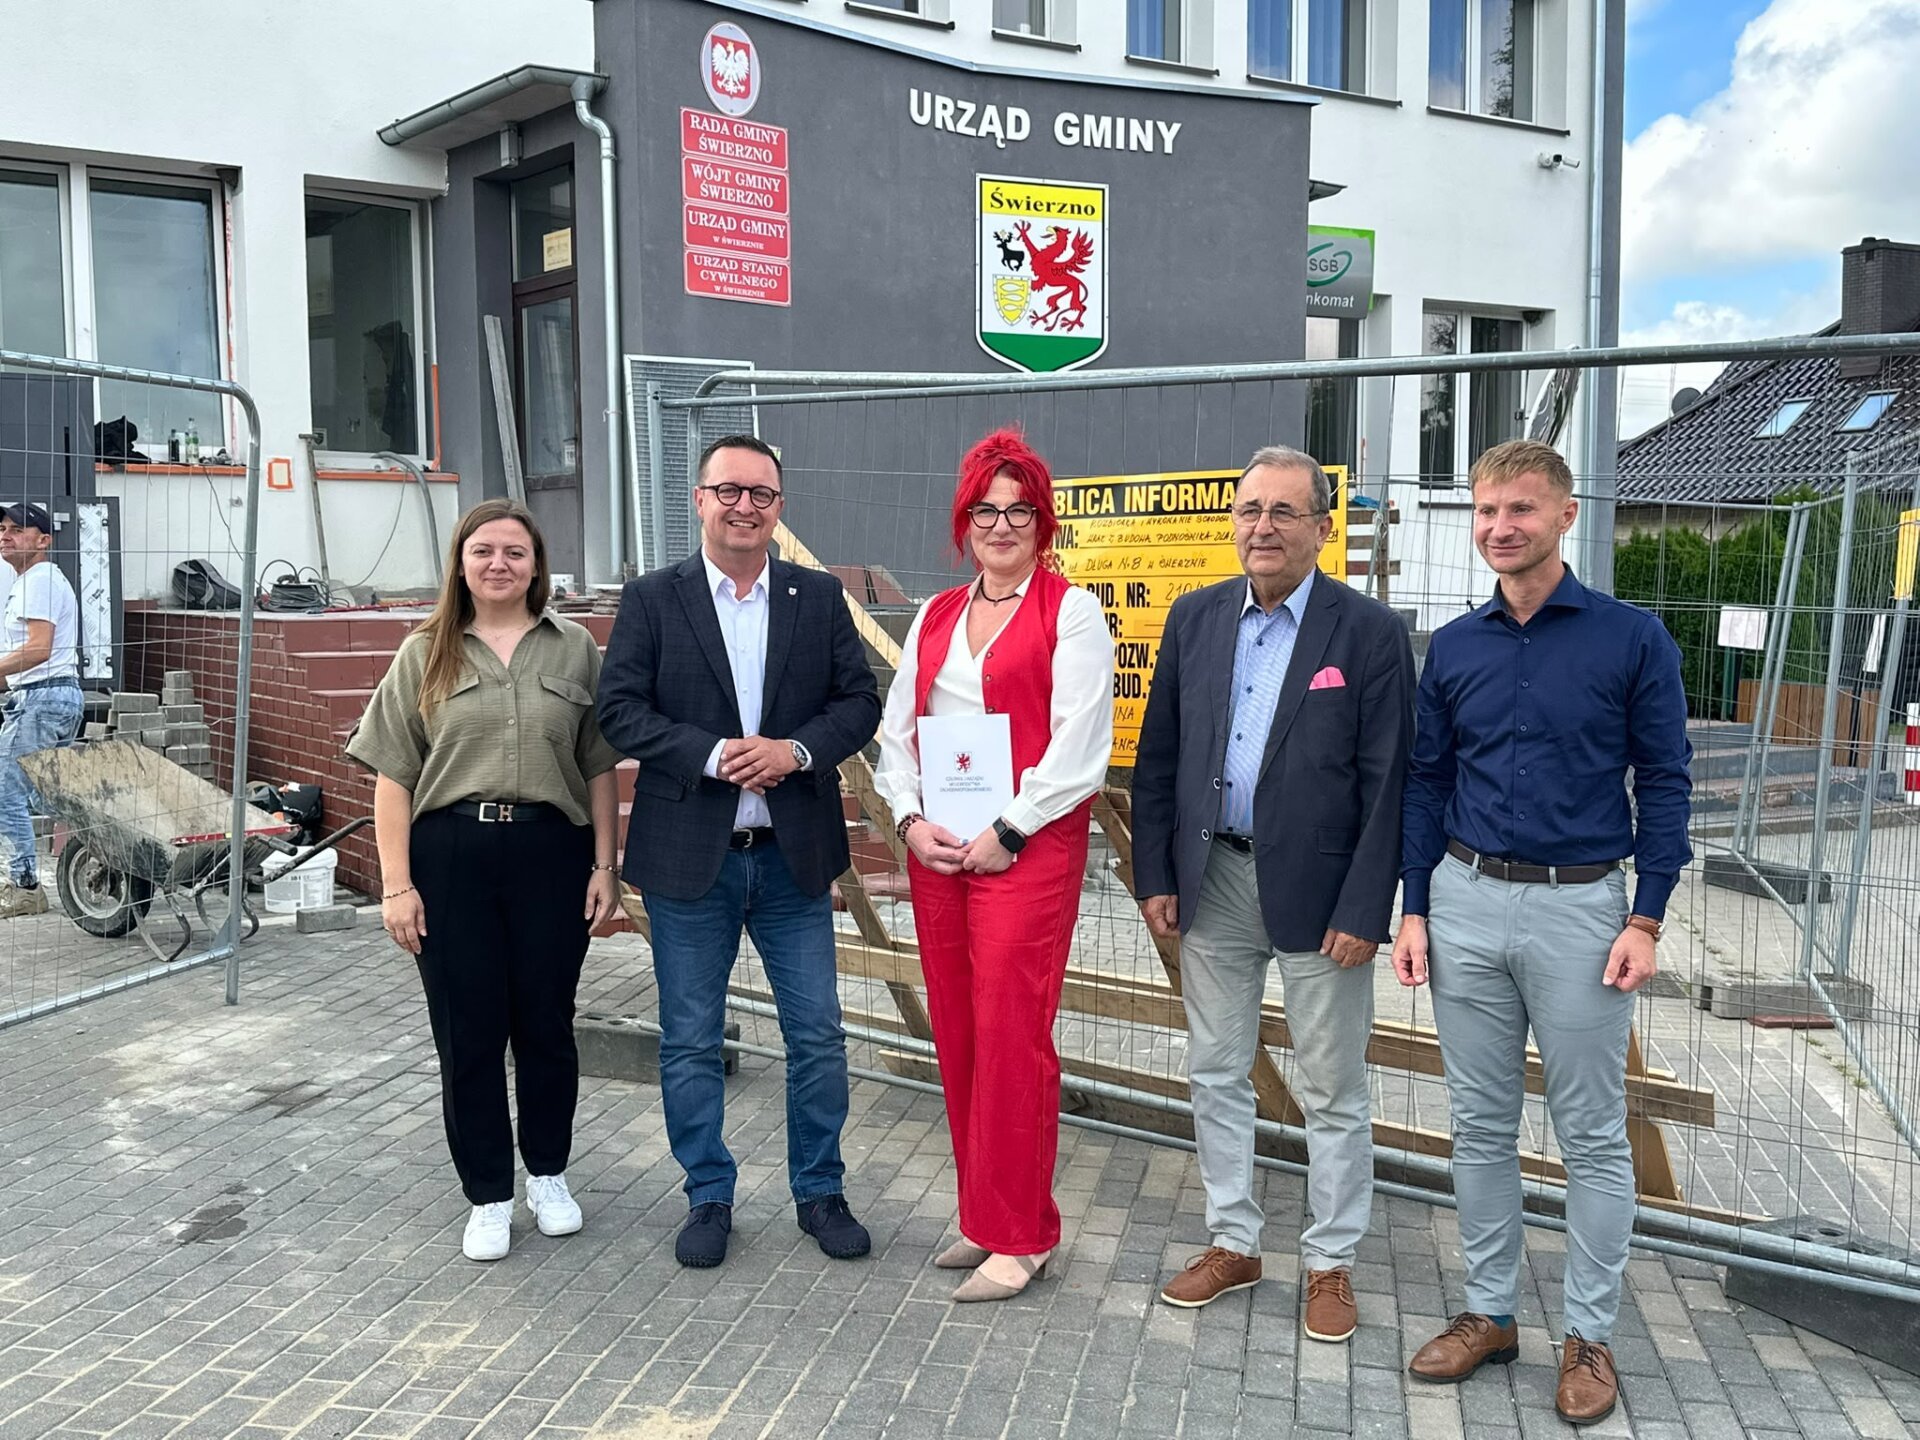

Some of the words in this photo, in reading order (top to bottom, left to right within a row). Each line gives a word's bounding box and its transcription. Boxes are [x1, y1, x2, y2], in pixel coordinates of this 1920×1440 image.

[690, 114, 731, 136] RADA
[733, 123, 780, 145] GMINY
[909, 88, 1031, 148] URZĄD
[1053, 111, 1182, 154] GMINY
[698, 133, 773, 163] ŚWIERZNO
[691, 163, 731, 183] WÓJT
[735, 172, 781, 192] GMINY
[700, 180, 774, 208] ŚWIERZNO
[989, 187, 1096, 216] Świerzno
[688, 210, 737, 233] URZĄD
[741, 219, 786, 239] GMINY
[693, 254, 739, 271] URZĄD
[742, 261, 783, 276] STANU
[700, 269, 778, 289] CYWILNEGO
[1308, 258, 1339, 273] SGB
[1123, 481, 1236, 513] INFORMA
[1126, 582, 1150, 608] NR:
